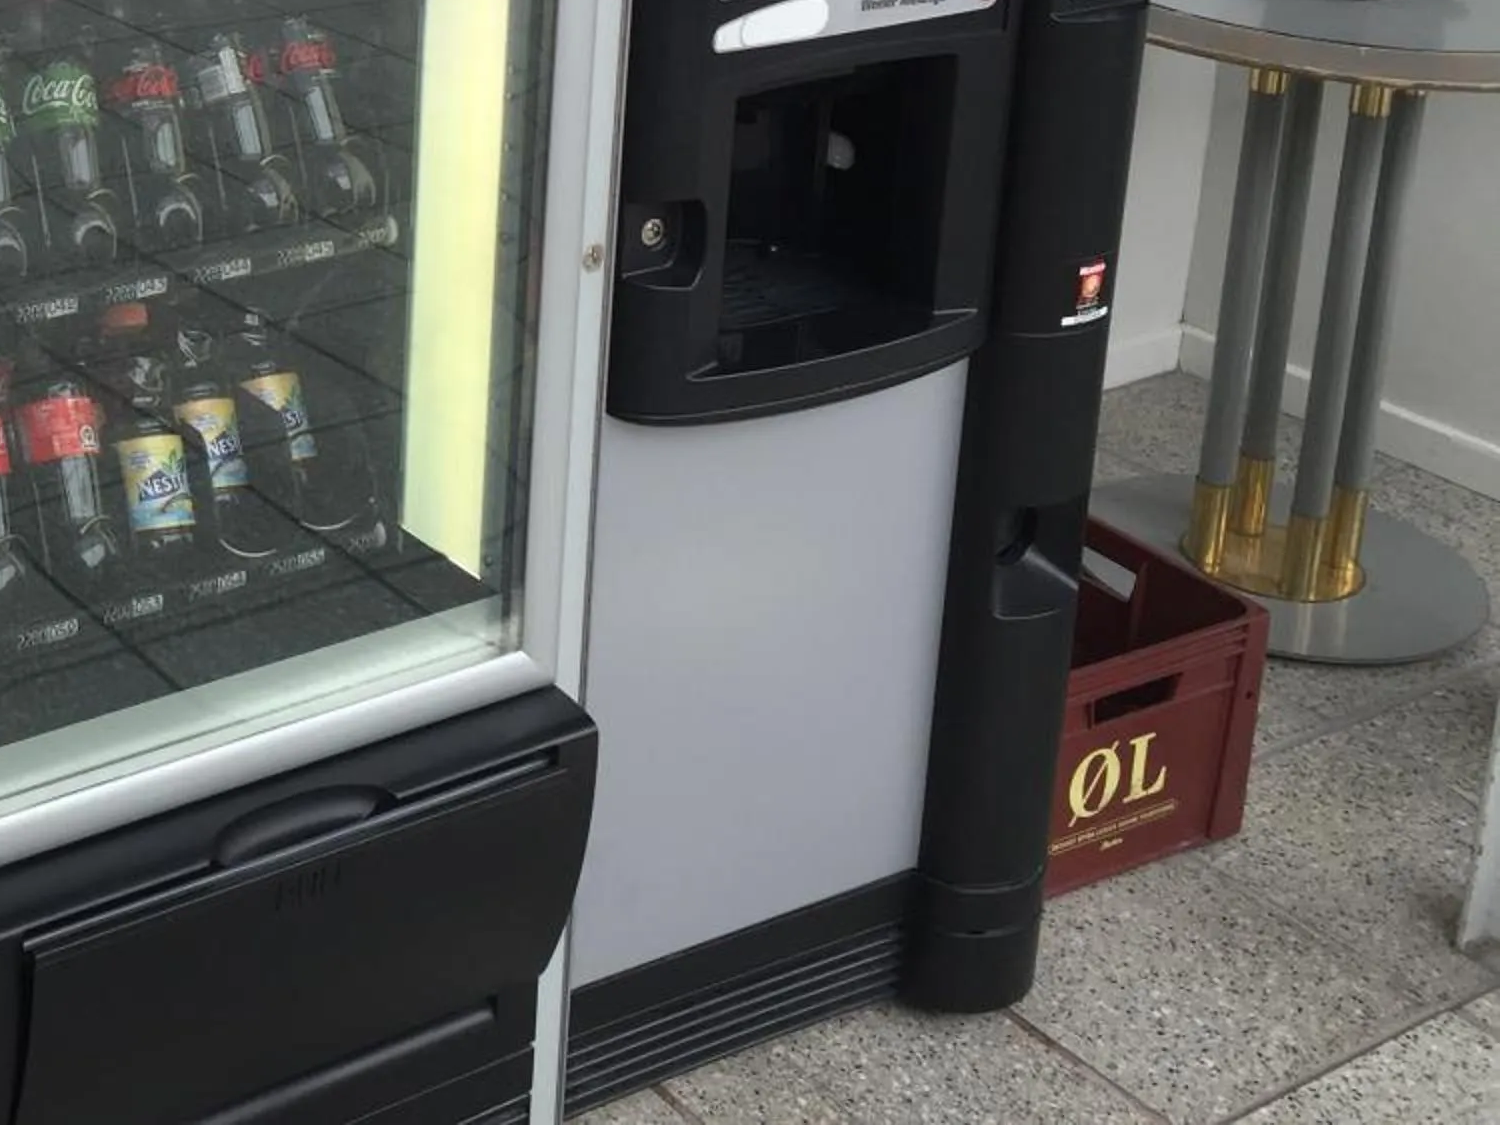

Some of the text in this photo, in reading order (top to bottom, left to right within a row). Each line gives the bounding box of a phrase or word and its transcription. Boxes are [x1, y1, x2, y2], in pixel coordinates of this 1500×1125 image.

[22, 73, 98, 117] Coca-Co
[139, 472, 188, 502] NEST
[1068, 732, 1167, 828] ØL
